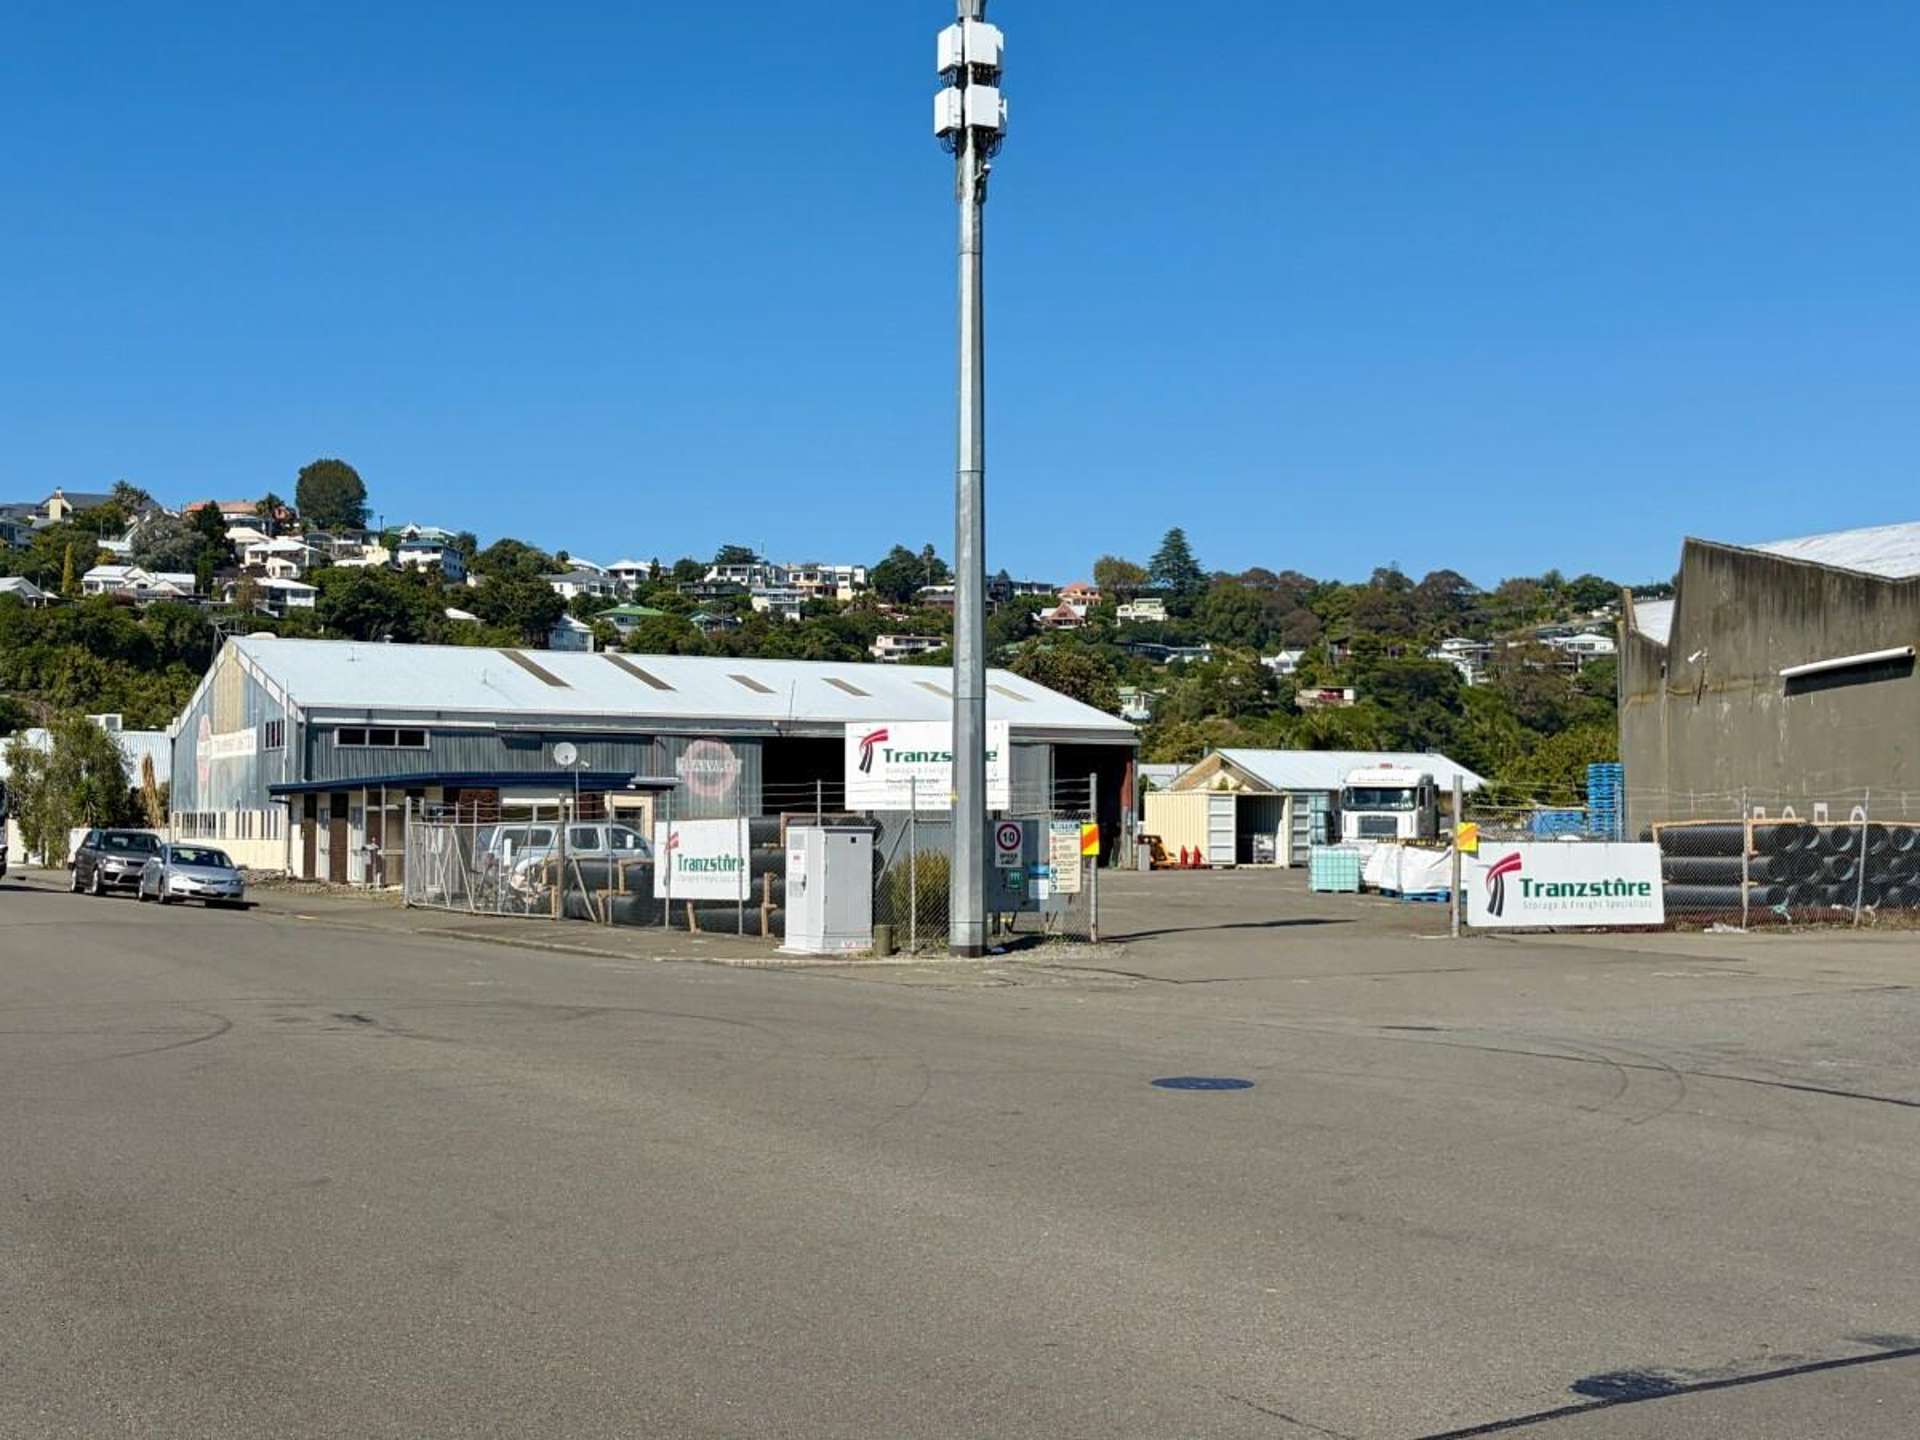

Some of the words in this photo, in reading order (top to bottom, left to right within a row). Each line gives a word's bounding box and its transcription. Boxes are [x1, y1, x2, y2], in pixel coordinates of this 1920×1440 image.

[1003, 832, 1015, 843] 10
[1522, 900, 1558, 911] Storage
[1570, 899, 1602, 911] Freight
